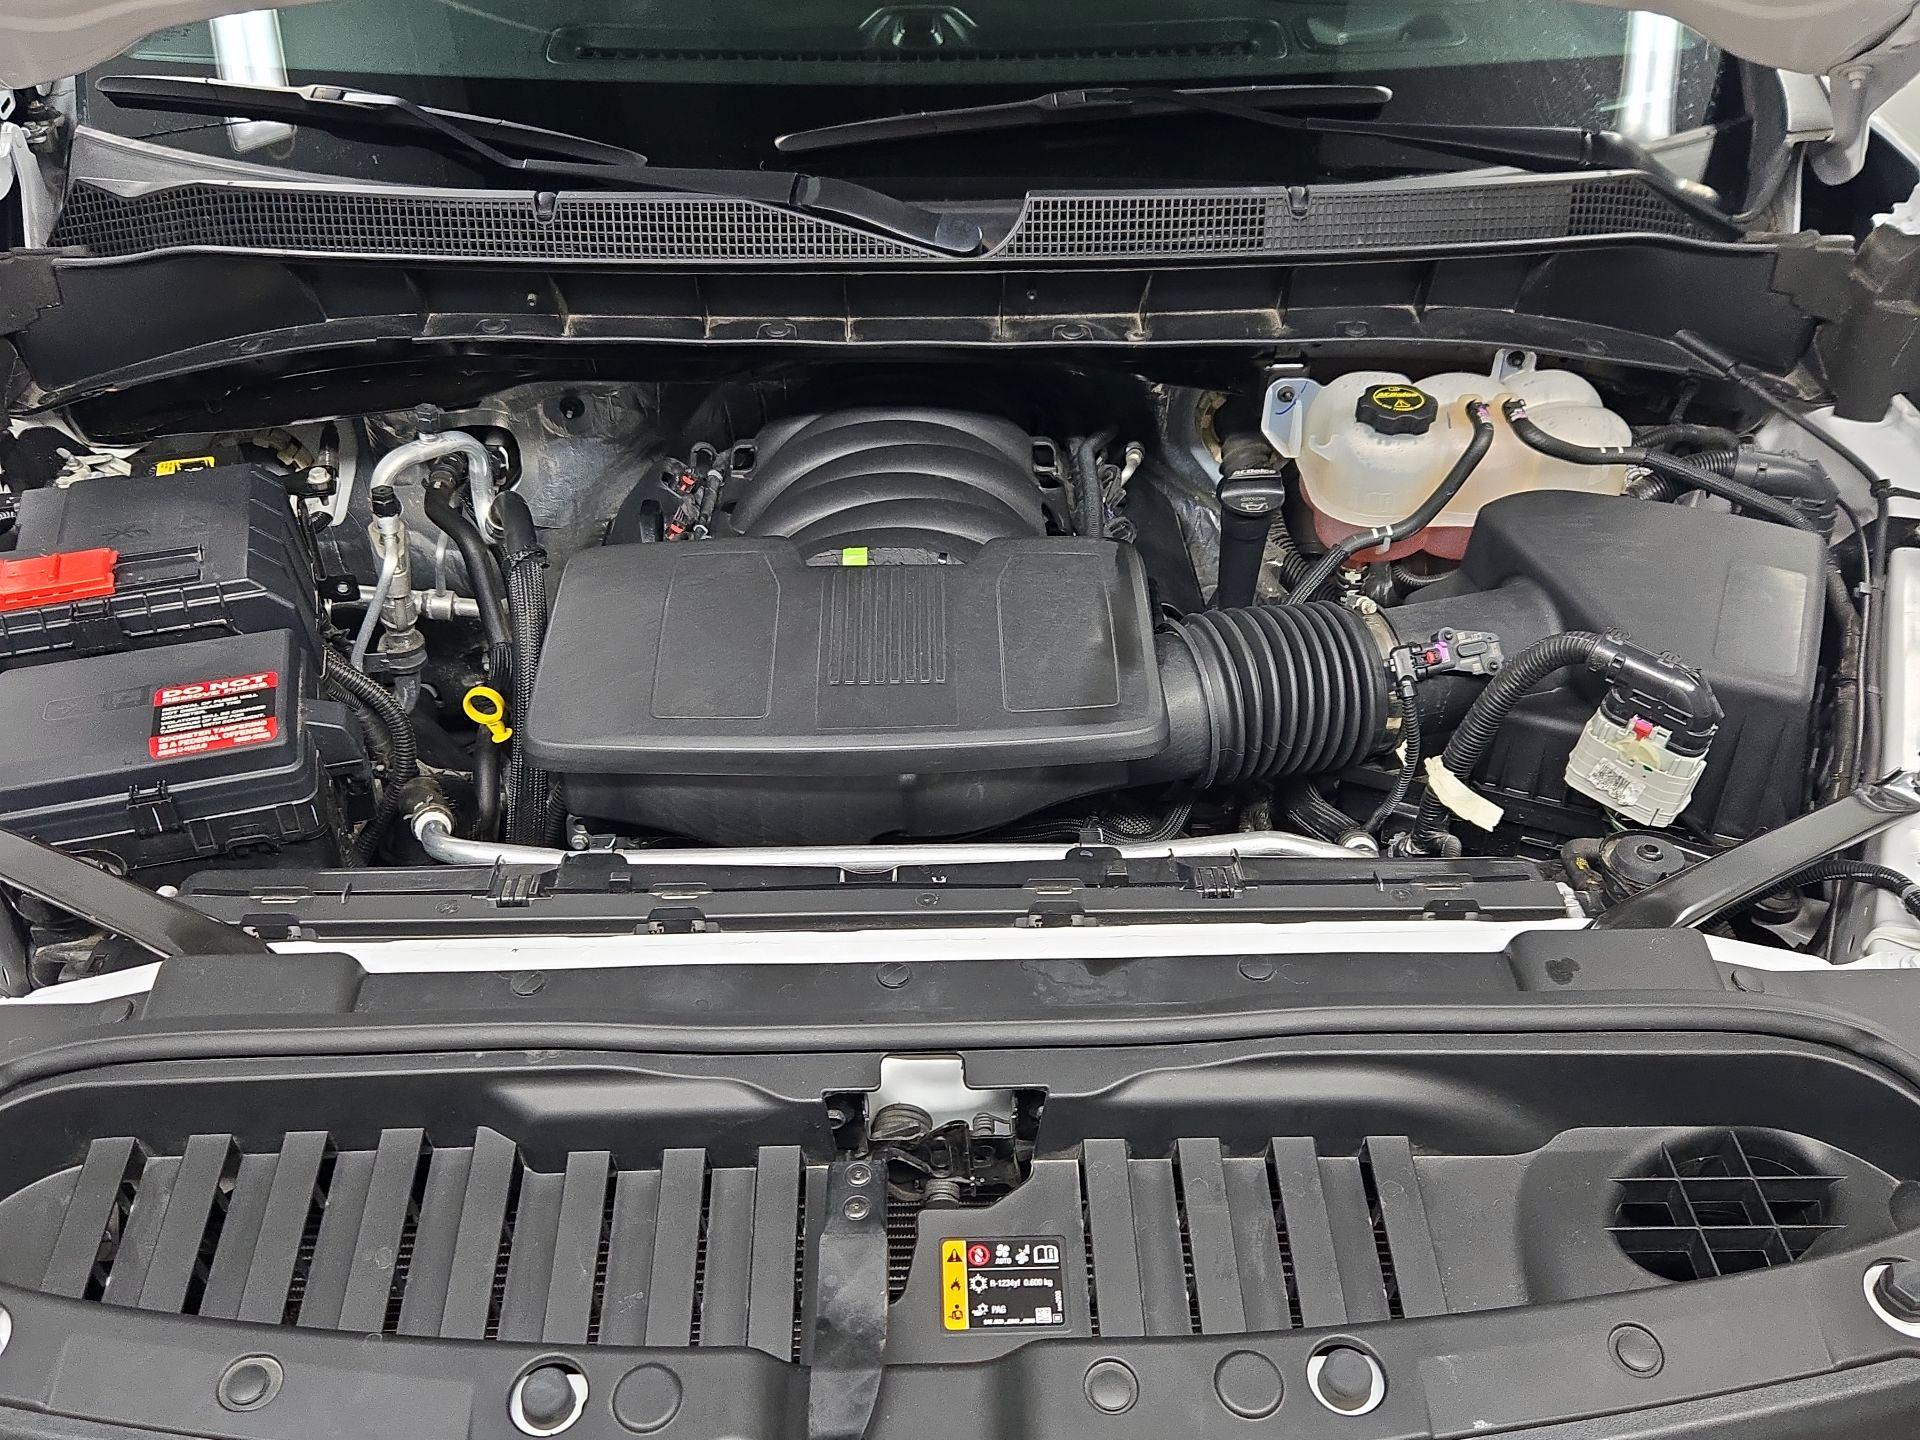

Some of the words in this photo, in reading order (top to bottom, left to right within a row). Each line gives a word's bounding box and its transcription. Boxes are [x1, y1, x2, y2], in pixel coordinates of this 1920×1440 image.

[1231, 468, 1276, 476] ACDelco
[162, 686, 204, 698] DO
[210, 674, 268, 691] NOT
[162, 690, 222, 704] REMOVE
[158, 730, 212, 743] ODOMETER
[212, 720, 268, 734] TAMPERING
[178, 734, 222, 747] FEDERAL
[995, 1257, 1012, 1265] AUTO
[1044, 1278, 1054, 1288] kg
[991, 1305, 1006, 1314] PAG
